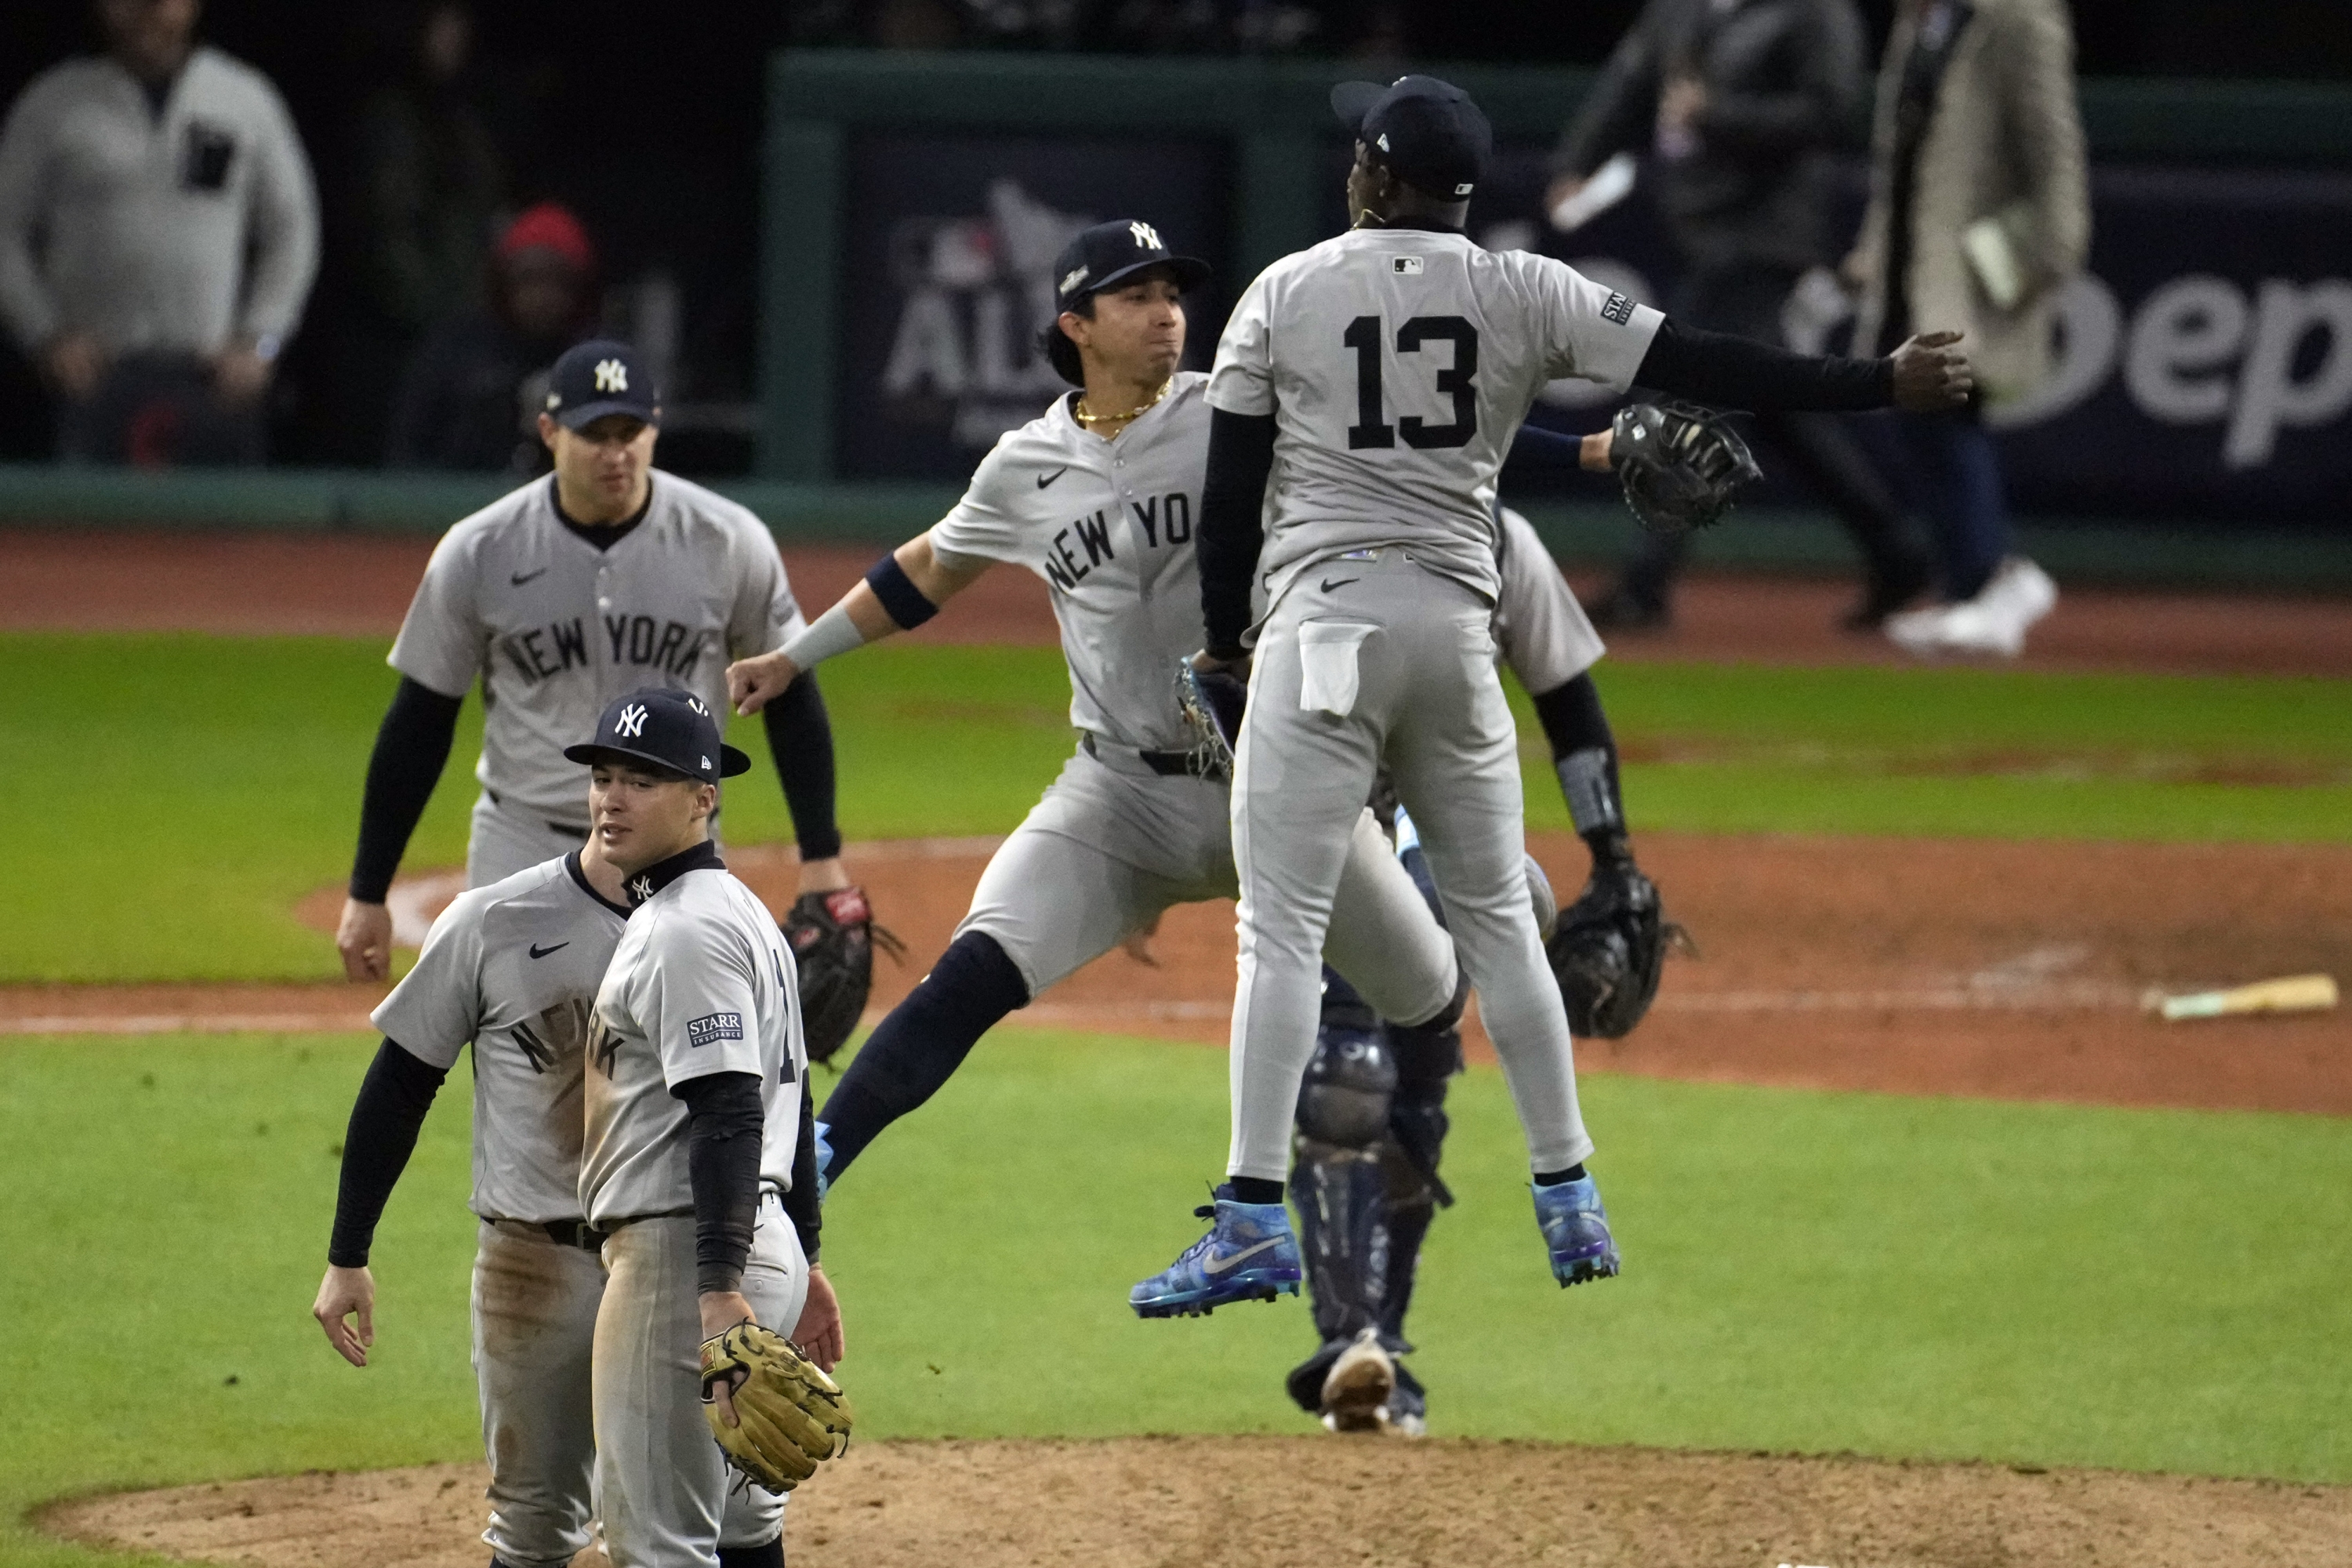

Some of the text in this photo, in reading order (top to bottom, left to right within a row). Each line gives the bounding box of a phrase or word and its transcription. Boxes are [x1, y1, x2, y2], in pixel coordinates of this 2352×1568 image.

[1344, 315, 1479, 450] 13
[1044, 510, 1115, 593] NEW
[615, 703, 648, 738] NY
[690, 1014, 741, 1036] STARR
[693, 1032, 741, 1045] INSURANCE
